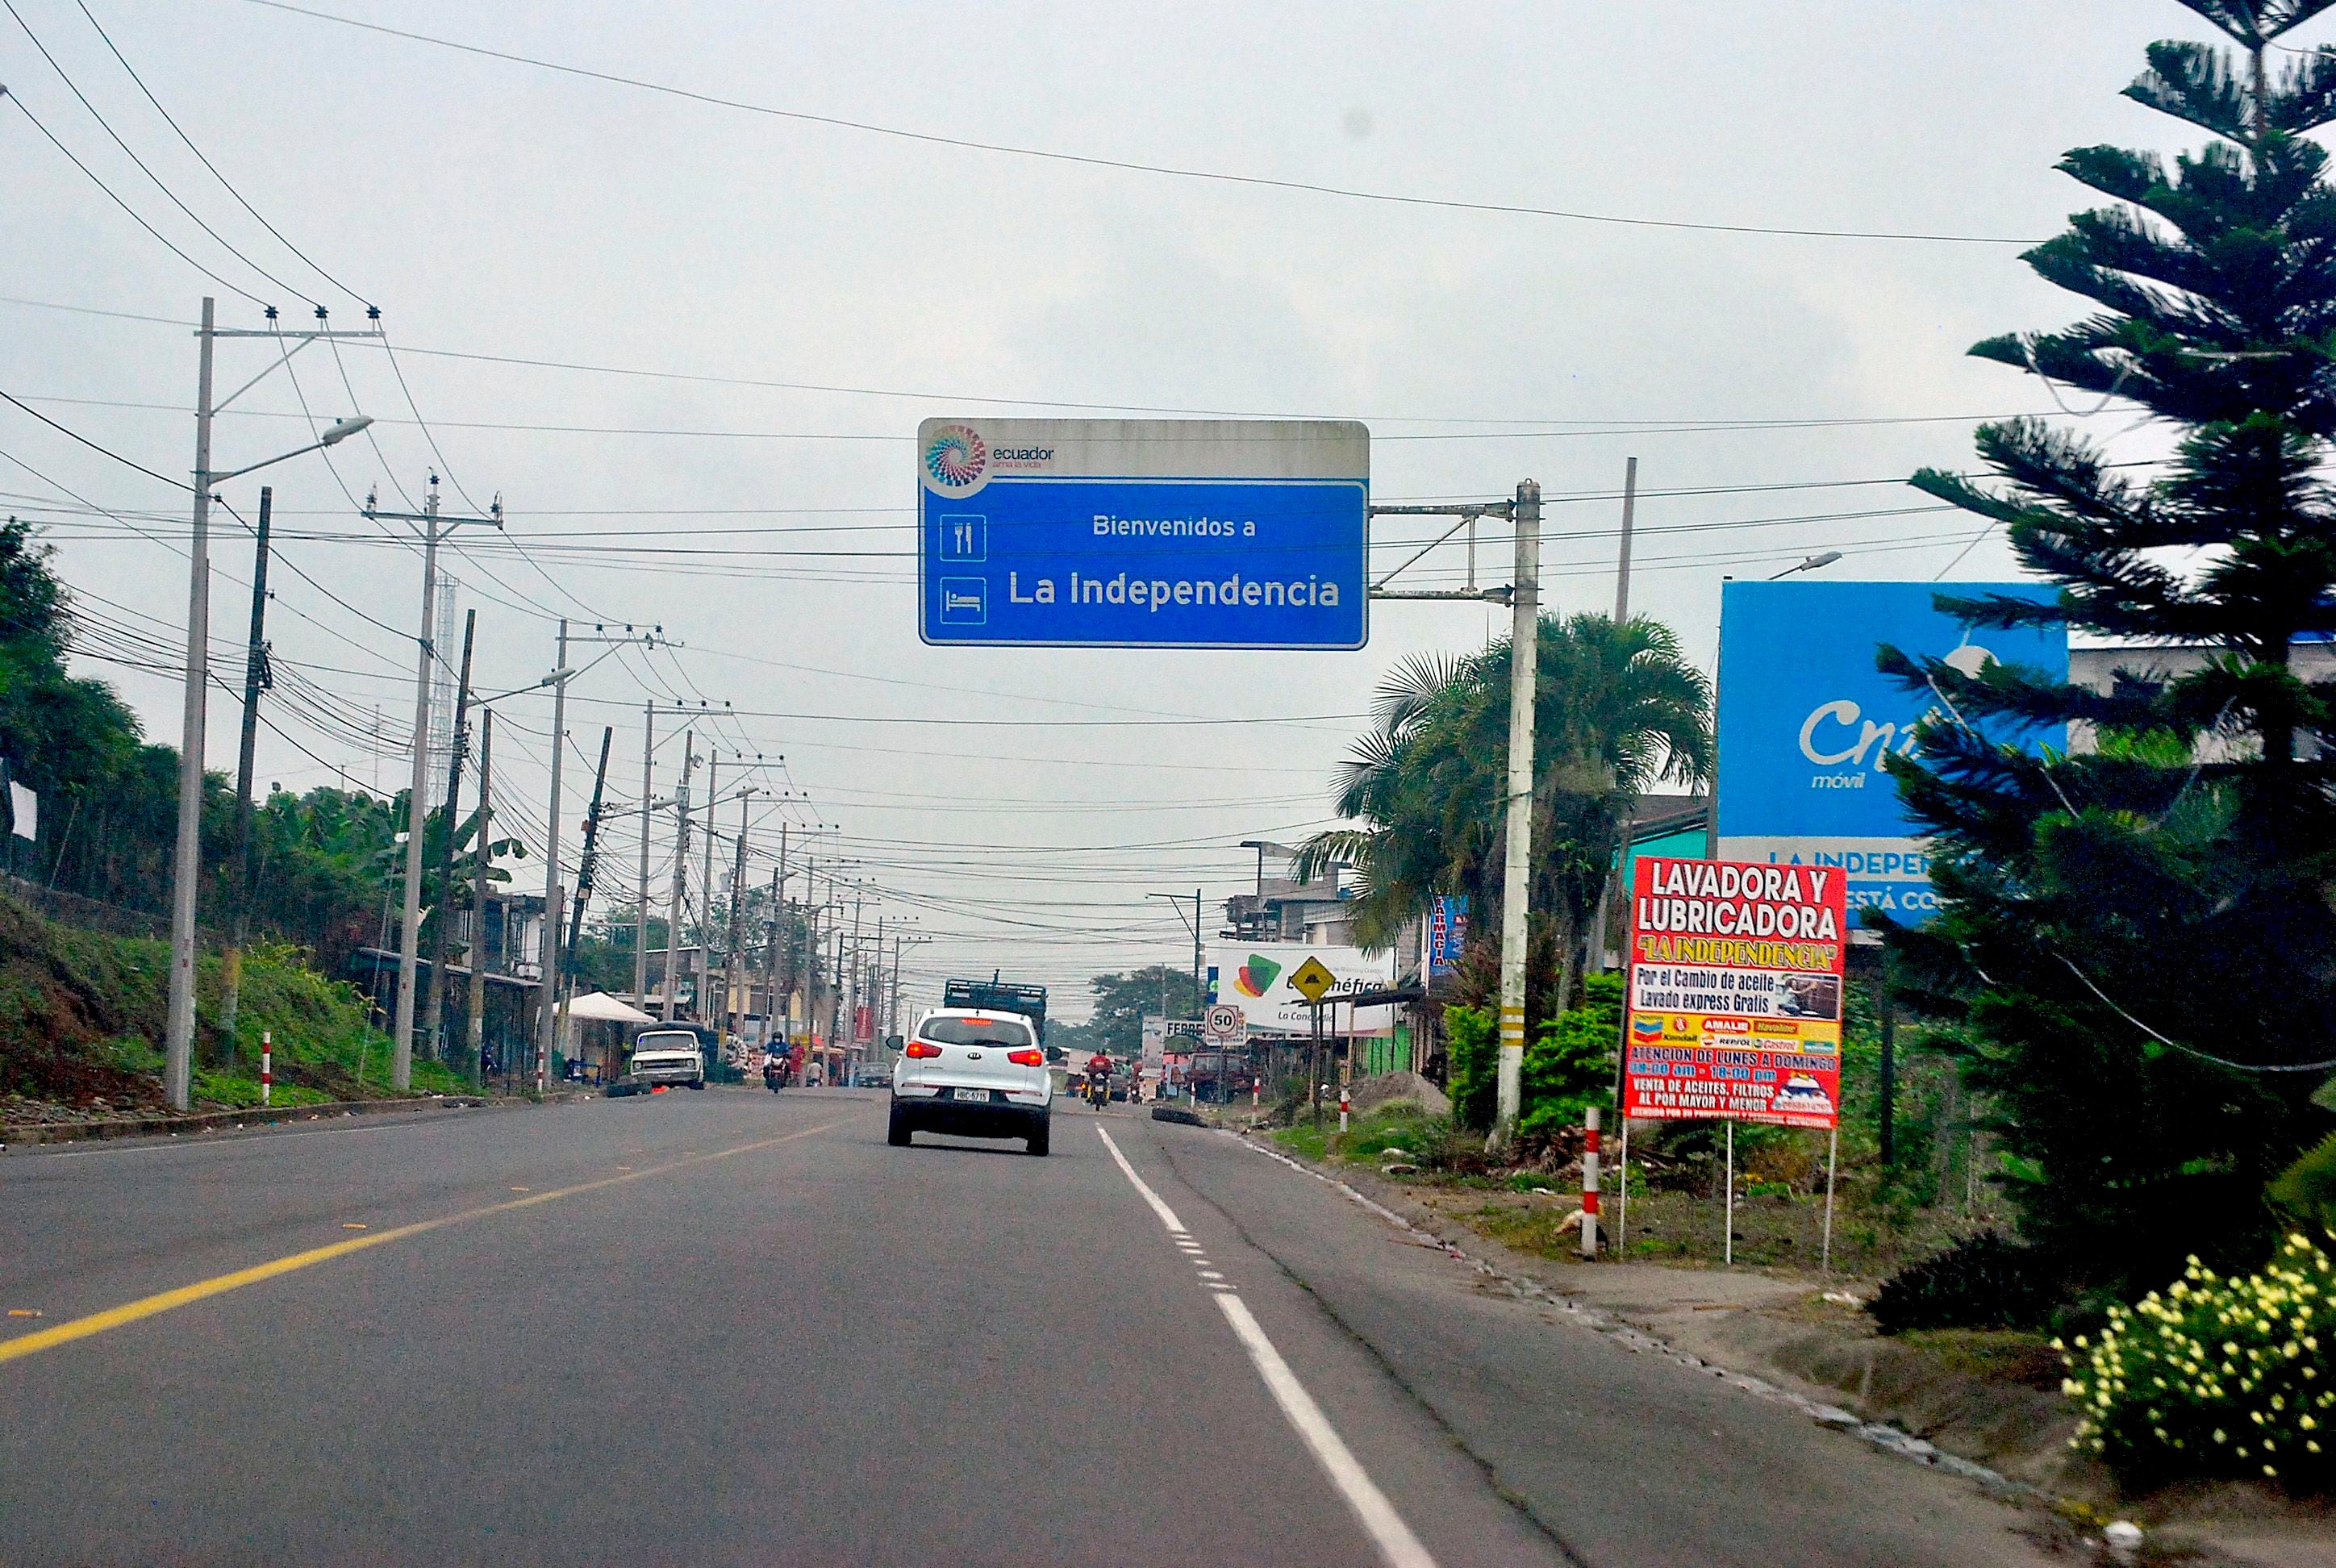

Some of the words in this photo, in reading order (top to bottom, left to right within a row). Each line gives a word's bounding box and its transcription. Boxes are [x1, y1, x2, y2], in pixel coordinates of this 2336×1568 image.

[993, 446, 1054, 461] ecuador
[1093, 515, 1235, 536] Bienvenidos
[1243, 523, 1256, 537] a
[1010, 571, 1055, 604] La
[1070, 573, 1340, 613] Independencia
[1811, 770, 1866, 790] móvil
[1814, 852, 1933, 874] INDEPEN
[1651, 861, 1802, 903] LAVADORA
[1809, 869, 1828, 904] Y
[1901, 891, 1936, 910] CO
[1637, 897, 1838, 941] LUBRICADORA
[1432, 896, 1447, 966] FARMACIA
[1637, 968, 1658, 986] Por
[1660, 968, 1671, 986] el
[1674, 969, 1717, 989] Cambio
[1721, 971, 1735, 989] de
[1738, 973, 1775, 991] aceite
[1640, 989, 1679, 1008] Lavado
[1683, 994, 1729, 1014] express
[1733, 993, 1769, 1013] Gratis
[1214, 1015, 1232, 1026] 50
[1279, 1011, 1288, 1020] La
[1167, 1022, 1205, 1035] FERRE
[1704, 1020, 1750, 1032] AMALIE
[1719, 1037, 1751, 1047] REPSOL
[1762, 1039, 1796, 1051] Castrol
[1696, 1049, 1712, 1063] DE
[1717, 1049, 1757, 1065] LUNES
[1762, 1052, 1770, 1066] A
[1775, 1053, 1835, 1070] DOMINGO
[1672, 1066, 1696, 1078] am
[1710, 1065, 1750, 1081] 18:00
[1753, 1070, 1776, 1082] pm
[1633, 1078, 1665, 1091] VENTA
[1668, 1079, 1681, 1092] DE
[1733, 1083, 1775, 1098] FILTROS
[1638, 1092, 1651, 1105] AL
[1654, 1093, 1675, 1106] POR
[1679, 1095, 1716, 1108] MAYOR
[1719, 1096, 1726, 1109] Y
[1729, 1097, 1767, 1112] MENOR
